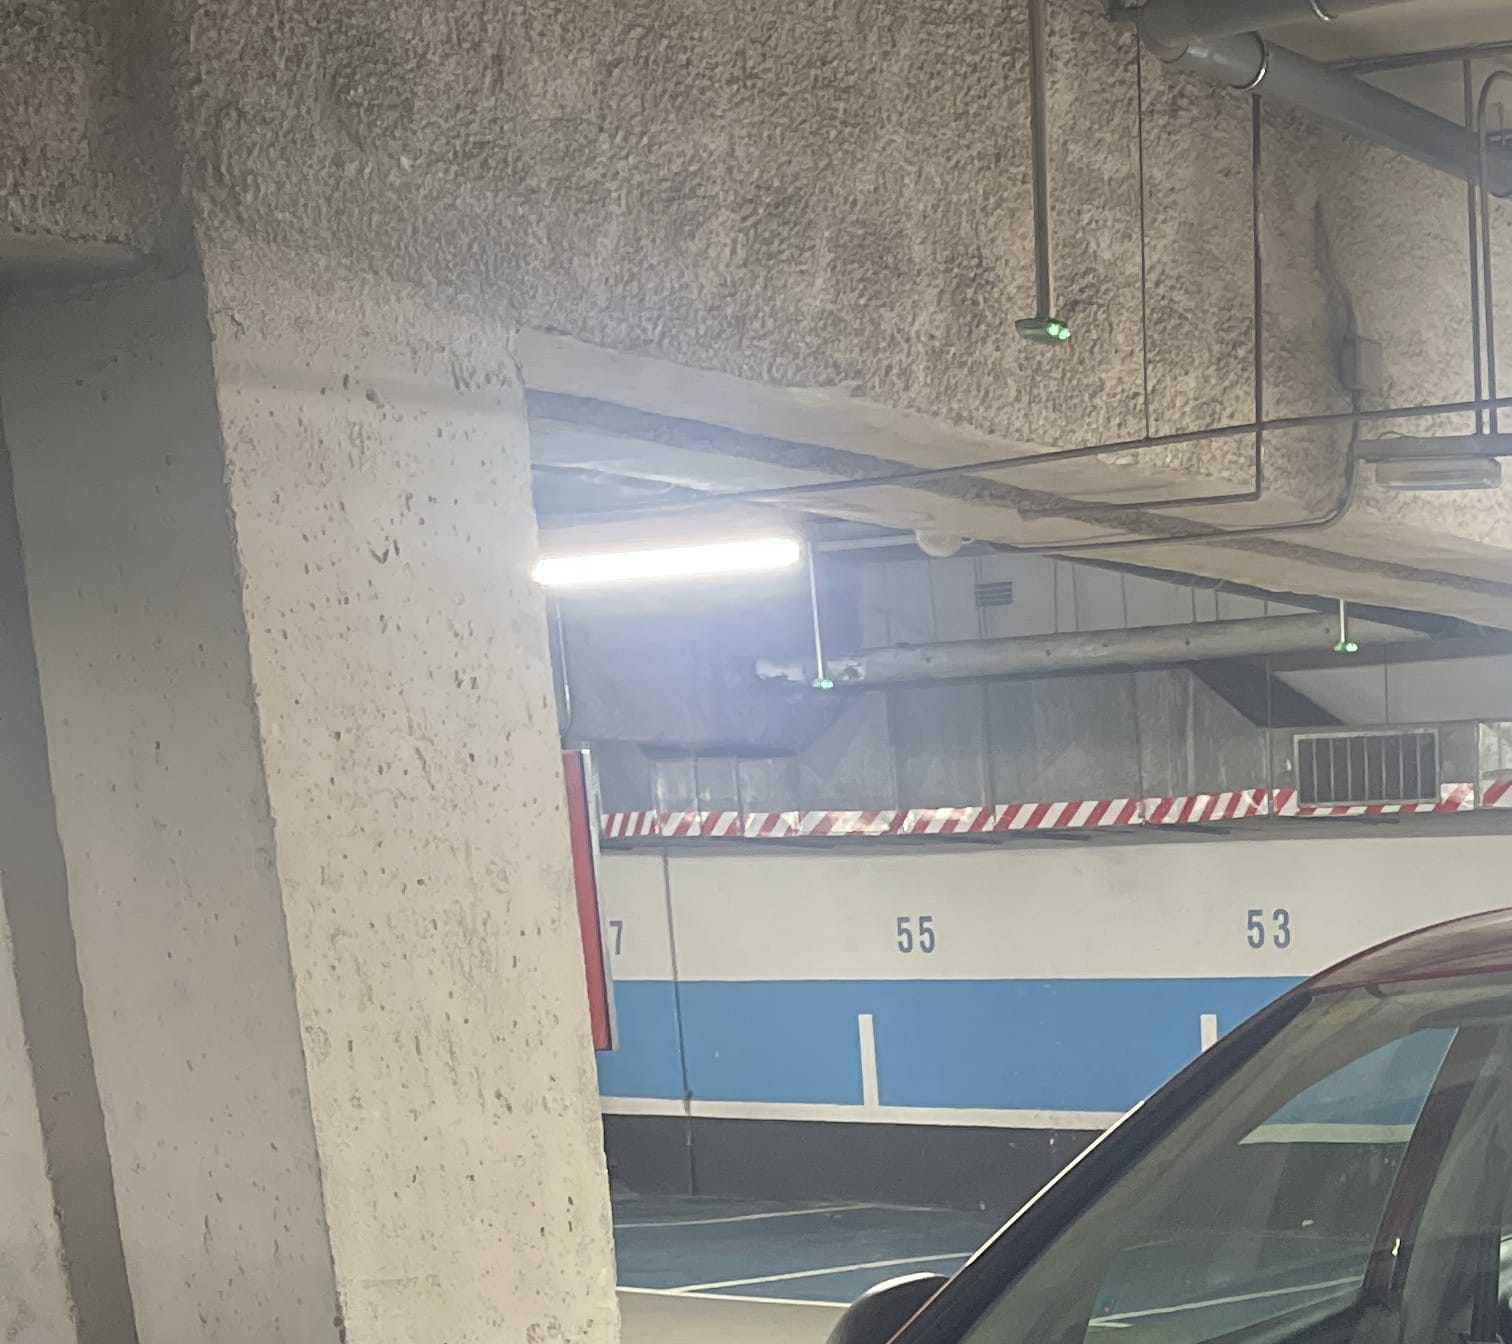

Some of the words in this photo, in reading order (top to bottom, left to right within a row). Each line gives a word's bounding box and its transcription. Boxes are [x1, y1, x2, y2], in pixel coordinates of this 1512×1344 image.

[609, 920, 623, 955] 7
[896, 915, 936, 953] 55
[1246, 908, 1291, 949] 53
